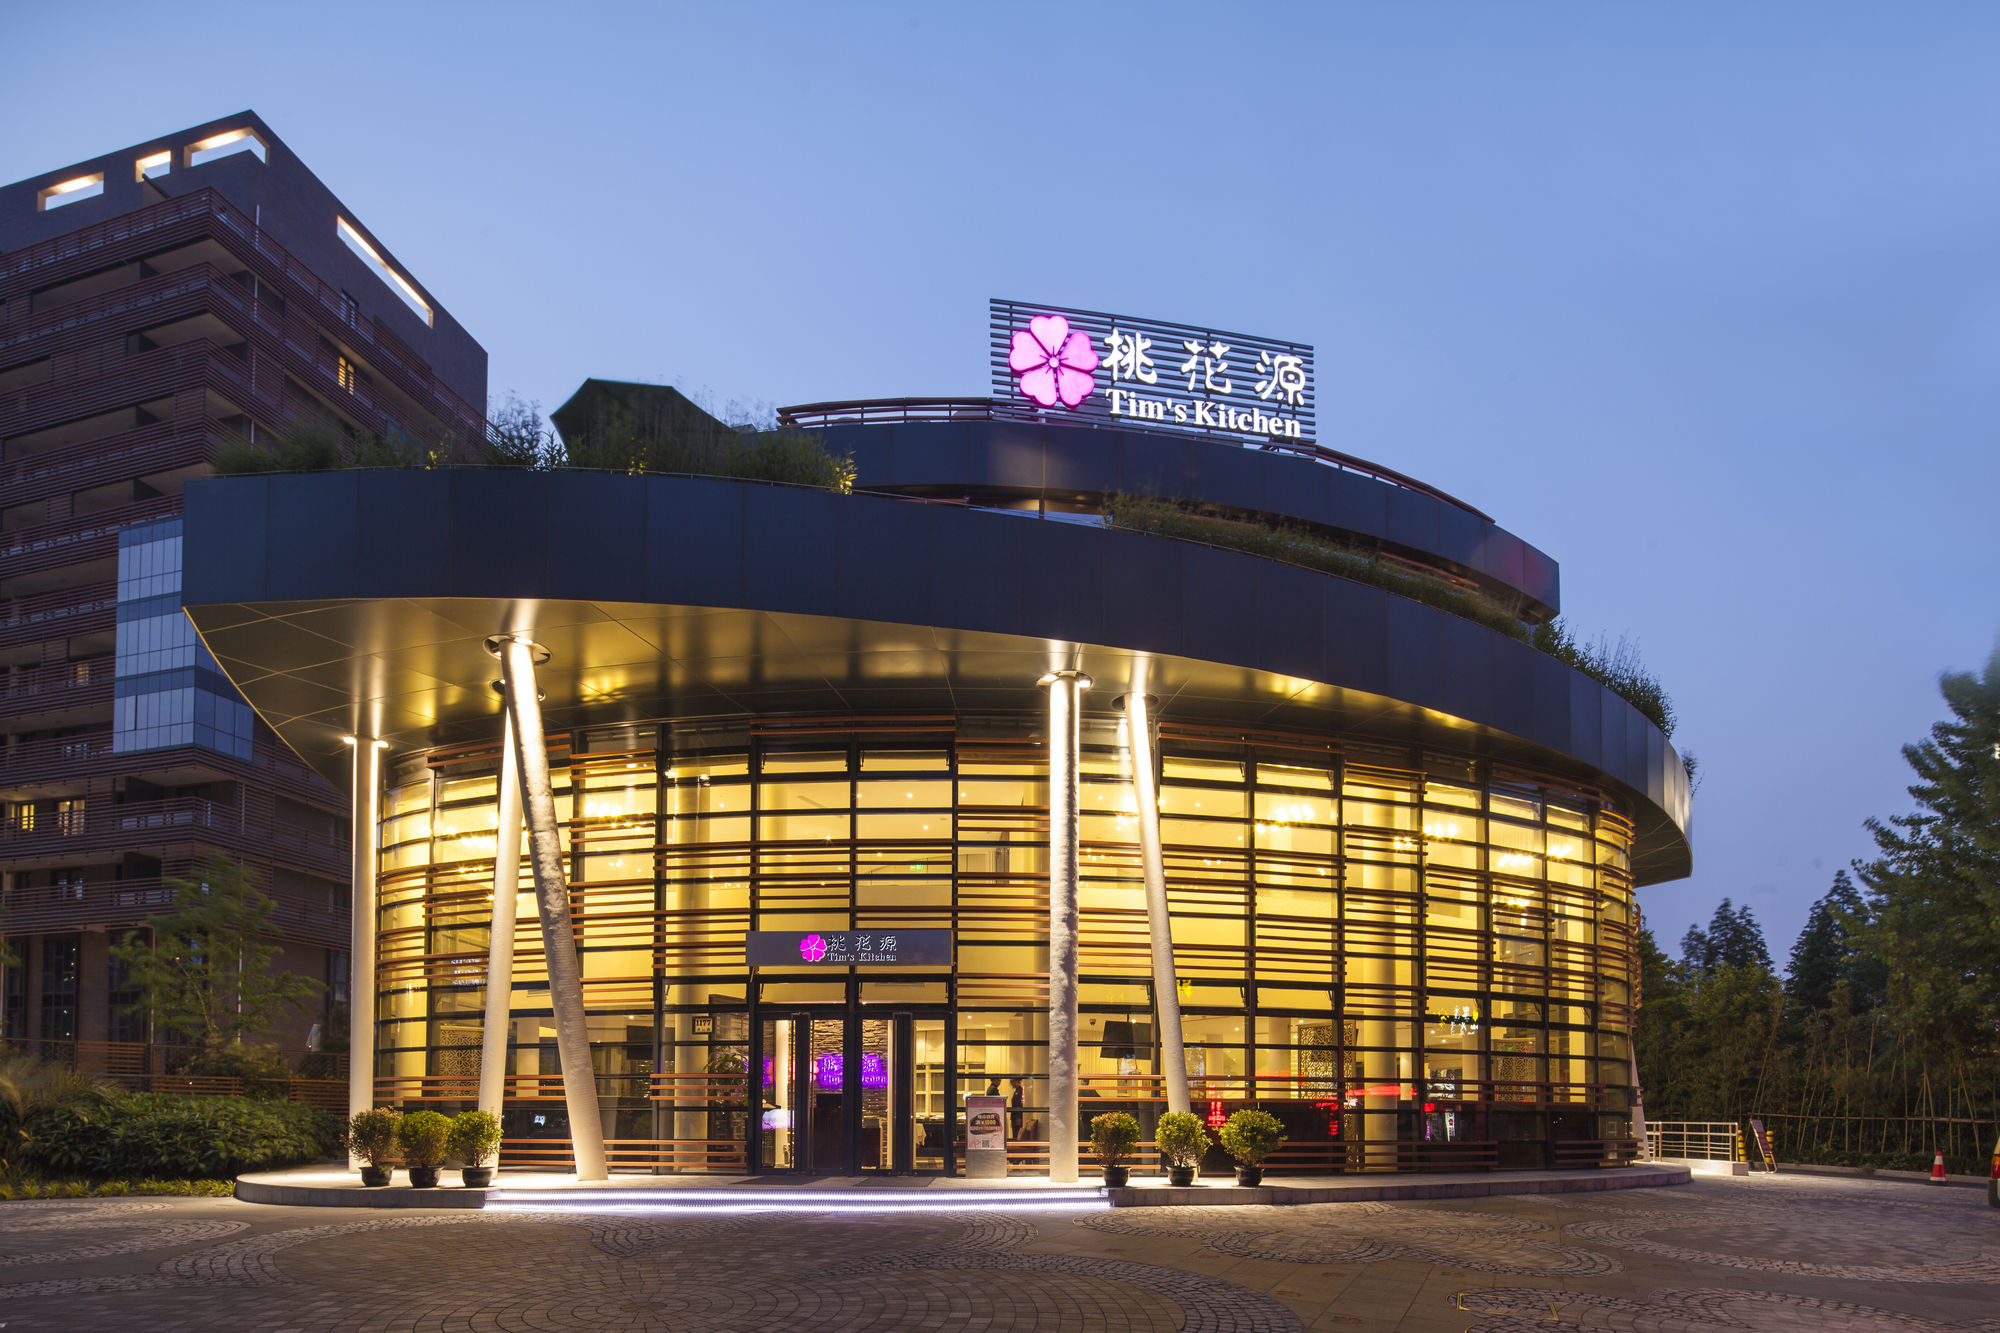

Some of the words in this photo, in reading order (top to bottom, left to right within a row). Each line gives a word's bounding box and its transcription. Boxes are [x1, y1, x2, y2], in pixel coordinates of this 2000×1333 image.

[1102, 329, 1306, 405] 桃花源
[1105, 388, 1187, 423] Tim's
[1194, 400, 1301, 437] Kitchen
[827, 934, 897, 951] 桃花源
[827, 952, 855, 962] Tim's
[859, 952, 897, 962] Kitchen
